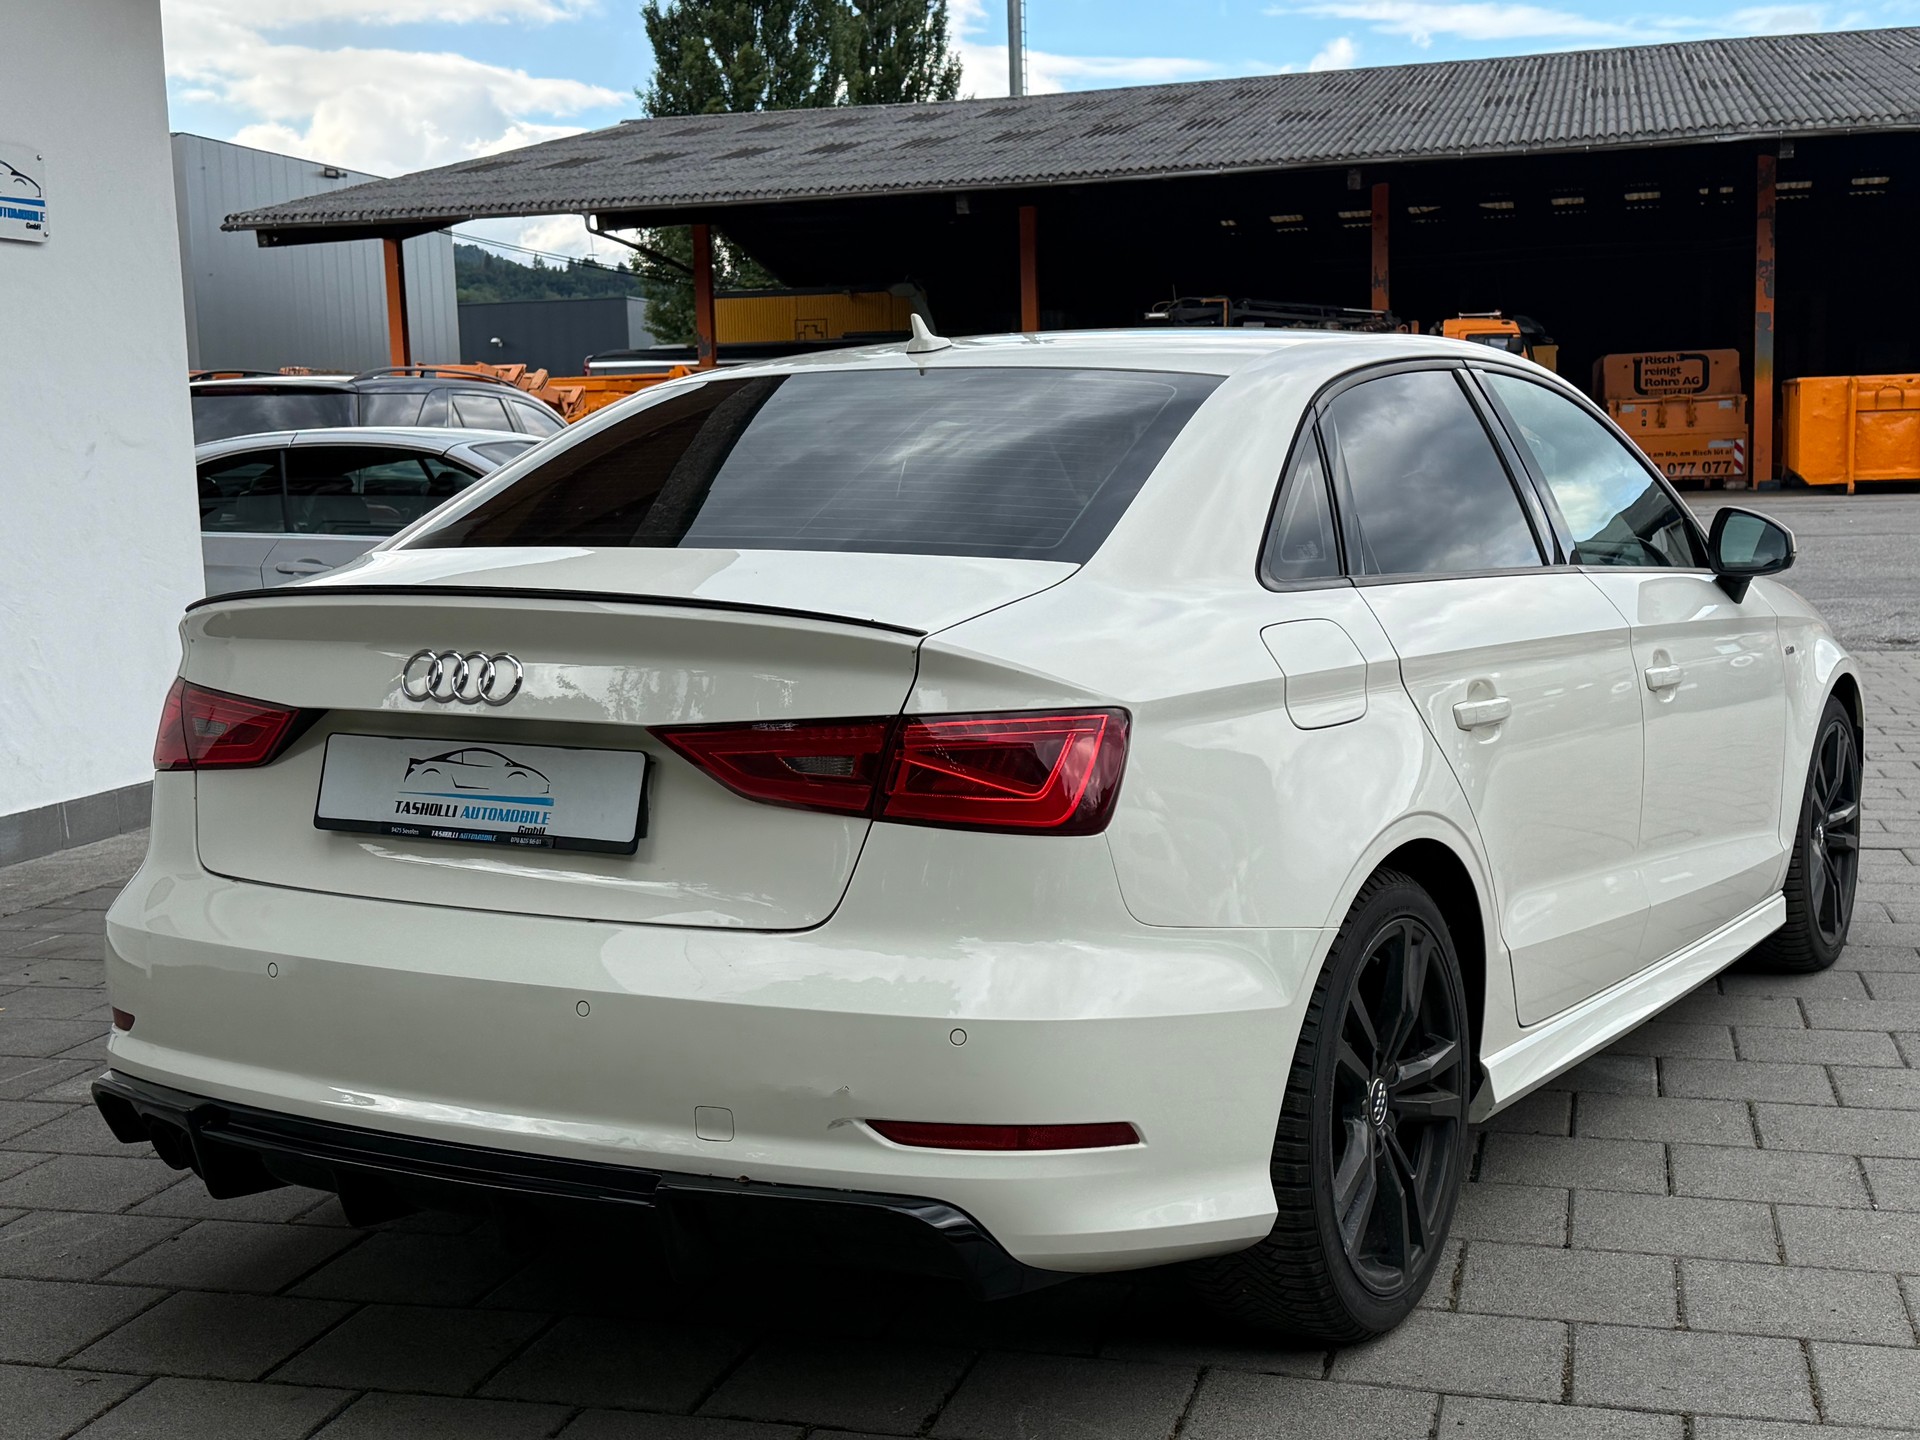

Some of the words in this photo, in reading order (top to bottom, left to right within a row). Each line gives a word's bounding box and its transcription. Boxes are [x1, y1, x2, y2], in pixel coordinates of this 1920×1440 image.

[1645, 355, 1675, 365] Risch
[1645, 366, 1682, 377] reinigt
[1645, 378, 1680, 387] Rohre
[1682, 376, 1700, 385] AG
[1667, 462, 1696, 475] 077
[1702, 460, 1732, 474] 077
[395, 800, 458, 818] TASHOLLI
[460, 805, 552, 825] AUTOMOBILE
[431, 829, 459, 839] TASHOLLI
[459, 832, 497, 842] AUTOMOBILE
